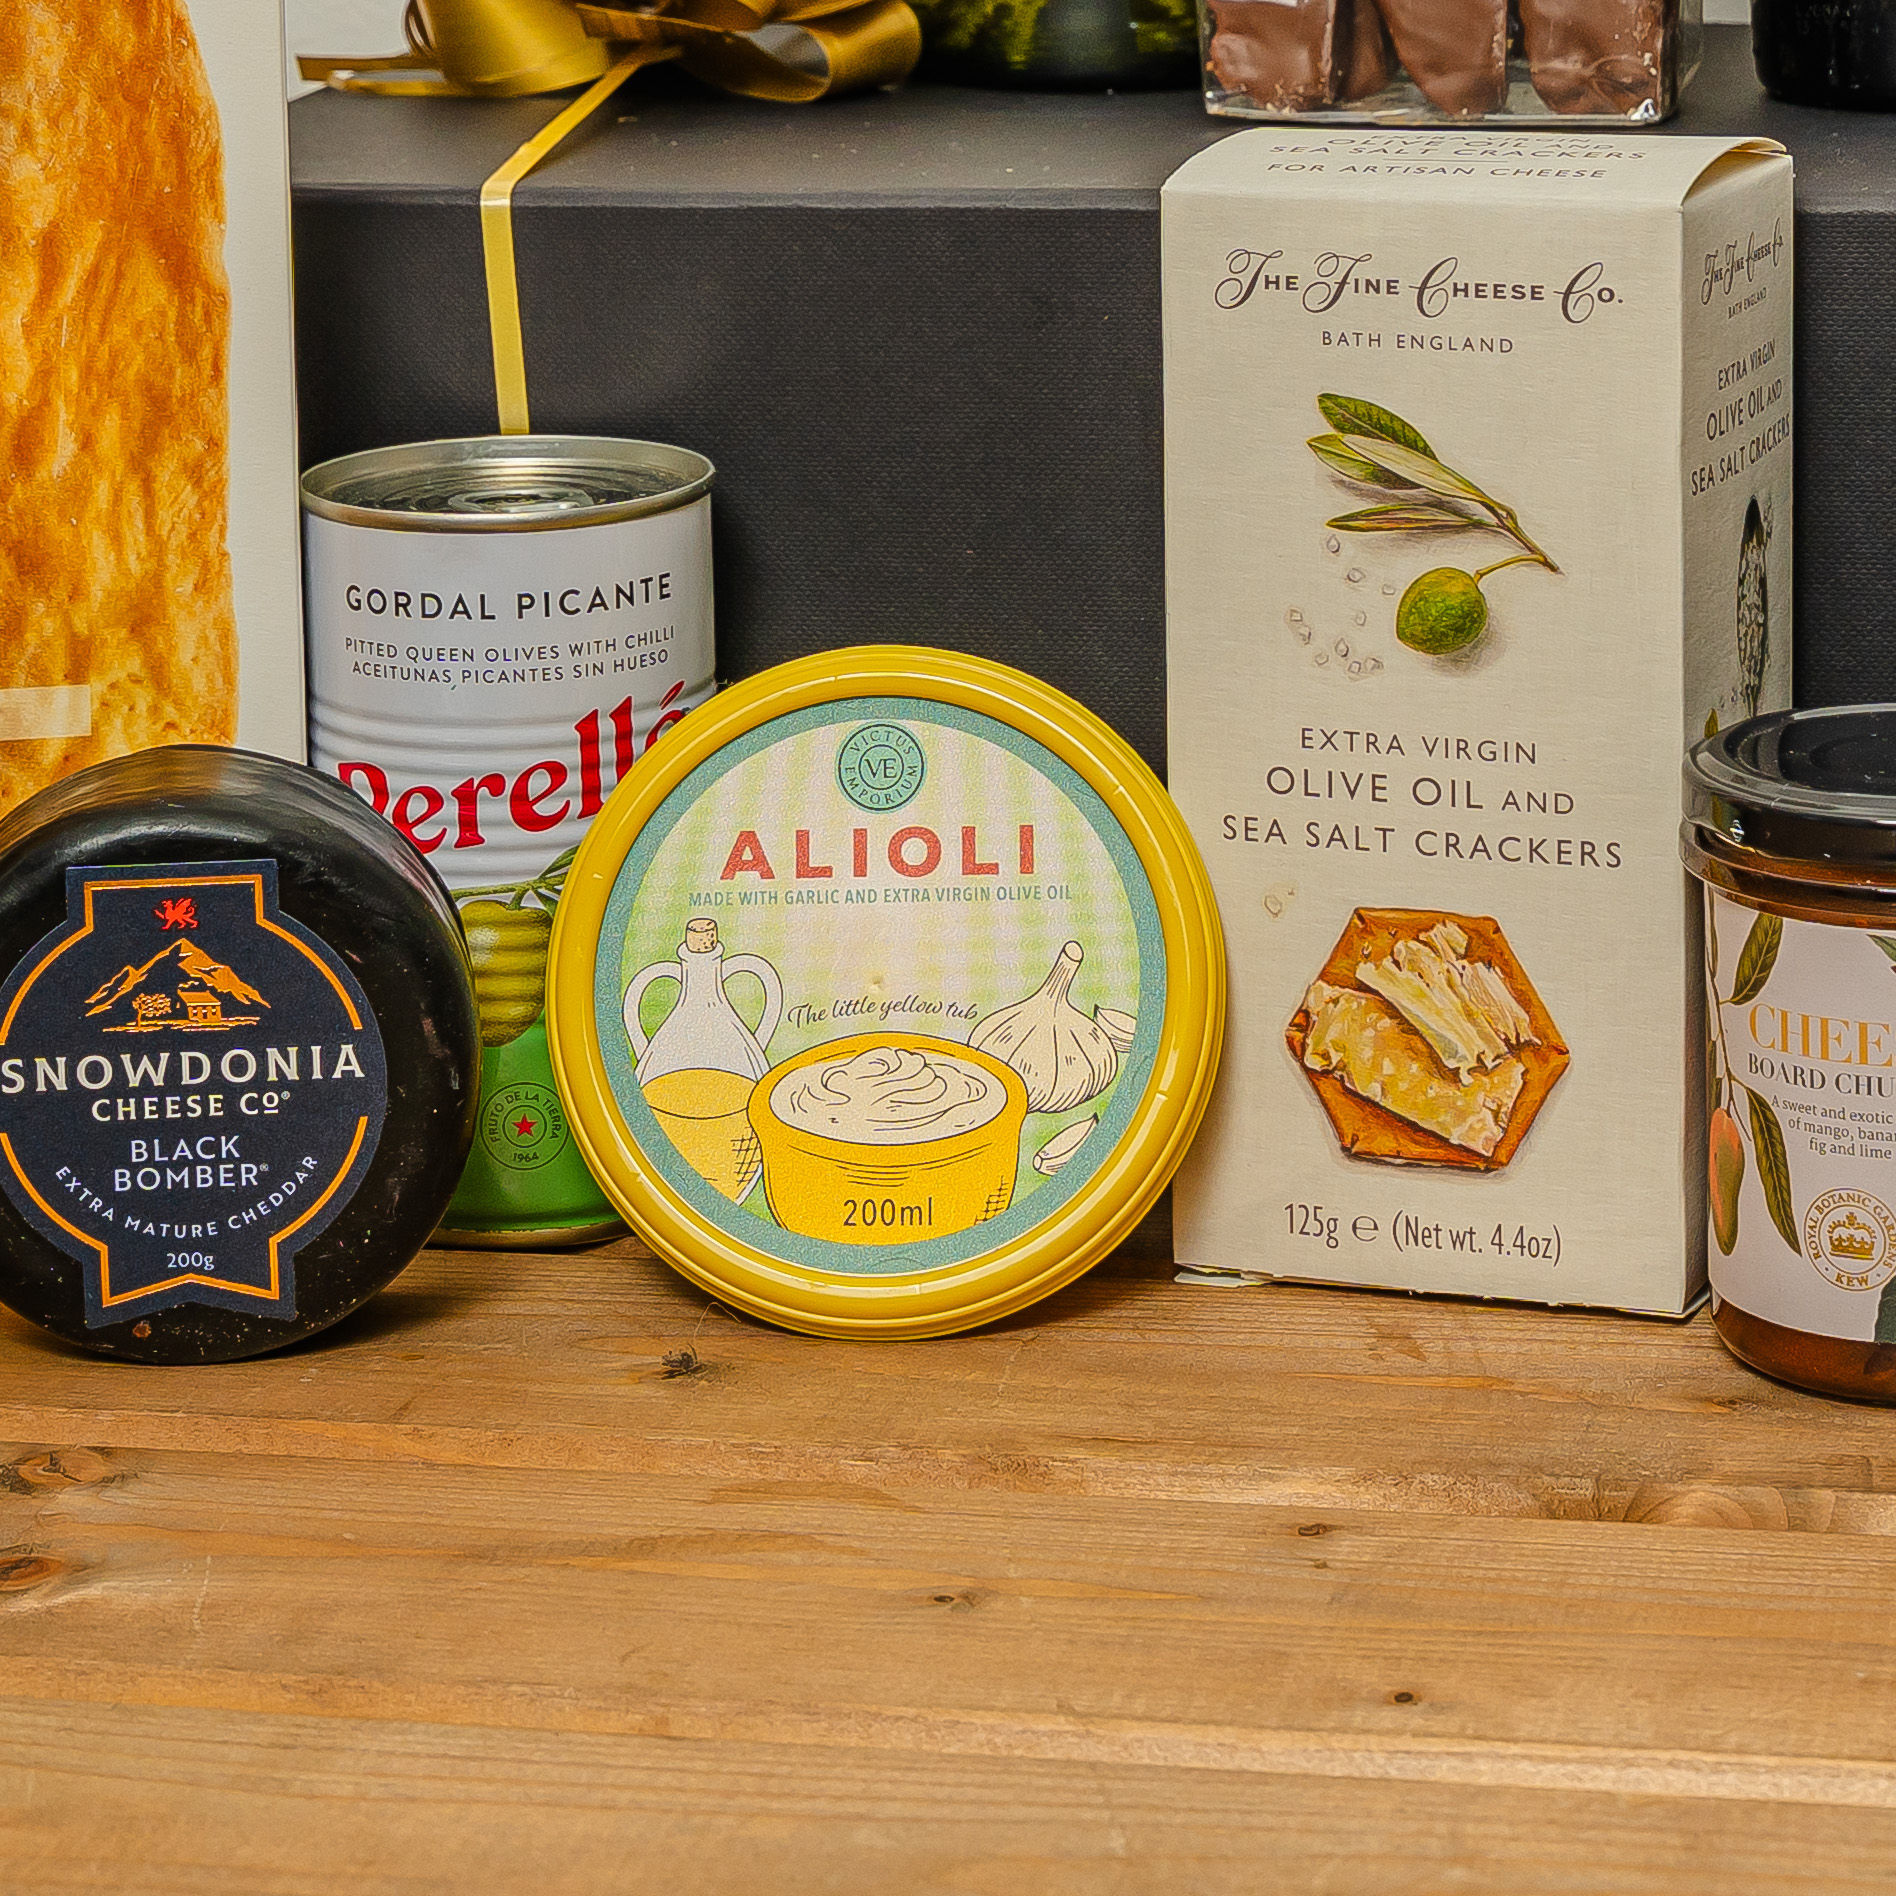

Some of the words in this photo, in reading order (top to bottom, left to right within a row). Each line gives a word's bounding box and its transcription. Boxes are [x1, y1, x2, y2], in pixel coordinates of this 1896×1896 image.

[1267, 164, 1326, 173] FOR
[1339, 165, 1474, 177] ARTISAN
[1489, 167, 1607, 180] CHEESE
[1321, 331, 1383, 348] BATH
[1396, 334, 1513, 353] ENGLAND
[346, 585, 497, 620] GORDAL
[517, 573, 671, 619] PICANTE
[345, 637, 397, 659] PITTED
[406, 646, 474, 663] QUEEN
[485, 645, 560, 662] OLIVES
[569, 638, 617, 657] WITH
[624, 625, 675, 649] CHILLI
[352, 661, 452, 683] ACEITUNAS
[462, 665, 563, 683] PICANTES
[573, 661, 605, 679] SIN
[613, 649, 668, 672] HUESO
[1300, 727, 1406, 757] EXTRA
[1421, 735, 1538, 765] VIRGIN
[1265, 765, 1390, 804] OLIVE
[1411, 776, 1484, 810] OIL
[1500, 790, 1575, 815] AND
[720, 824, 1034, 881] ALIOLI
[1221, 814, 1288, 845] SEA
[1305, 821, 1395, 854] SALT
[1414, 830, 1623, 869] CRACKERS
[689, 890, 734, 907] MADE
[738, 890, 778, 906] WITH
[784, 889, 839, 905] GARLIC
[845, 888, 878, 905] AND
[884, 886, 930, 903] EXTRA
[936, 885, 991, 902] VIRGIN
[996, 884, 1042, 901] OLIVE
[1047, 883, 1072, 901] OIL
[788, 1001, 826, 1030] The
[832, 995, 876, 1018] little
[880, 997, 941, 1019] yellow
[947, 1001, 979, 1021] tub
[1, 1043, 365, 1094] SNOWDONIA
[1749, 1052, 1826, 1093] BOARD
[92, 1094, 224, 1122] CHEESE
[1782, 1099, 1817, 1116] sweet
[1821, 1106, 1846, 1121] and
[1849, 1110, 1893, 1125] exotic
[1788, 1117, 1801, 1130] of
[1804, 1121, 1854, 1141] mango,
[130, 1135, 241, 1162] BLACK
[1809, 1137, 1826, 1155] fig
[1830, 1143, 1855, 1157] and
[1860, 1144, 1892, 1160] lime
[56, 1165, 115, 1222] EXTRA
[124, 1214, 218, 1239] MATURE
[228, 1155, 318, 1229] CHEDDAR
[843, 1198, 935, 1228] 200ml
[1284, 1203, 1340, 1249] 125g
[1392, 1209, 1443, 1253] (Net
[1448, 1223, 1483, 1254] wt.
[1490, 1221, 1562, 1268] 4.4oz)
[167, 1251, 214, 1271] 200g
